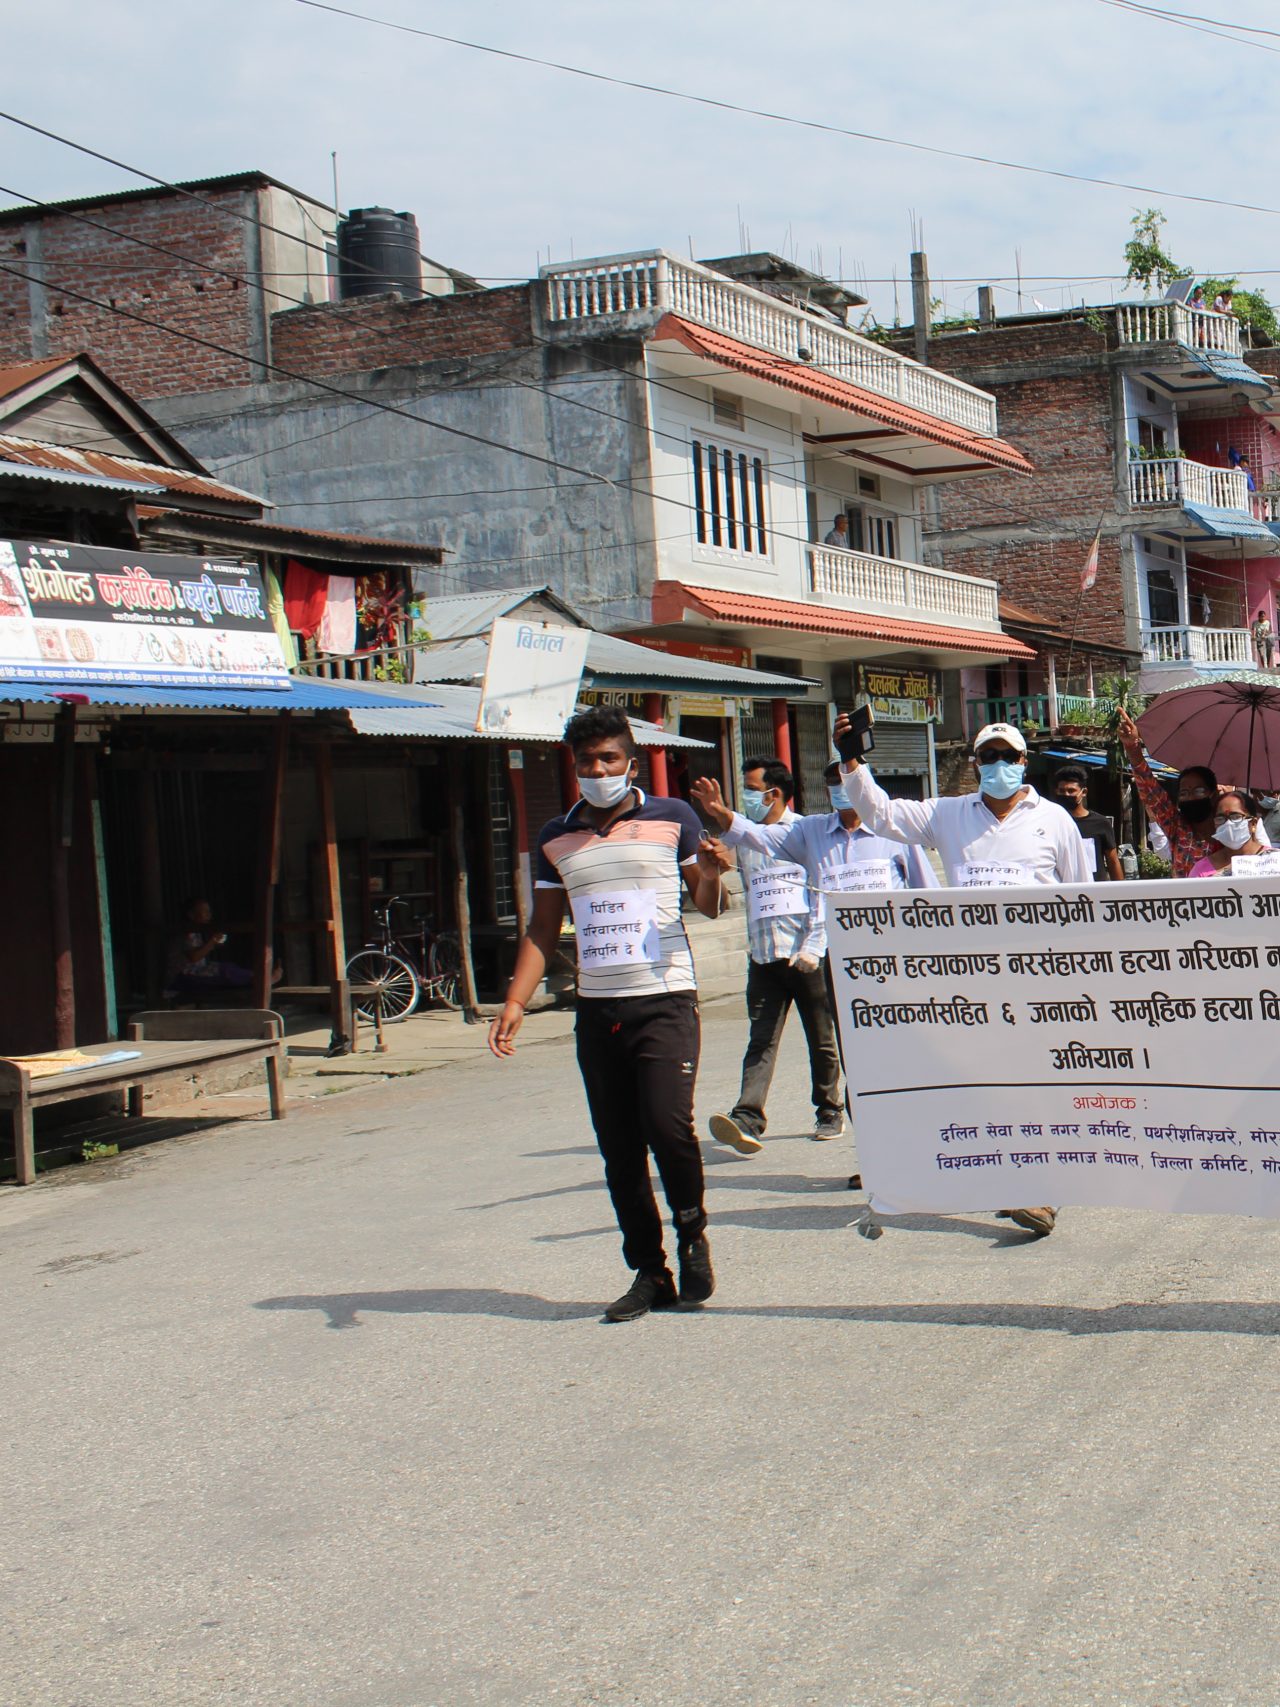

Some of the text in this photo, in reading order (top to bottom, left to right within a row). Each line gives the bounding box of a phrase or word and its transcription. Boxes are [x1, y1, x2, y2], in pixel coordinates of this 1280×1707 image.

[590, 901, 626, 915] पिडित
[835, 900, 895, 935] सम्पूर्ण
[900, 898, 954, 929] दलित
[959, 903, 998, 927] तथा
[1003, 894, 1095, 927] न्यायप्रेमी
[1100, 888, 1243, 928] जनसमूदायको
[903, 953, 1001, 979] हत्याकाण्ड
[1006, 947, 1114, 977] नरसंहारमा
[1119, 949, 1171, 975] हत्या
[1177, 939, 1259, 971] गरिएका
[851, 994, 989, 1029] विश्वकर्मासहित
[1001, 1002, 1016, 1026] ६
[1027, 993, 1098, 1024] जनाको
[1110, 990, 1196, 1028] सामूहिक
[1202, 998, 1253, 1023] हत्या
[1050, 1041, 1134, 1070] अभियान
[1073, 1092, 1137, 1110] आयोजक
[939, 1122, 979, 1143] दलित
[985, 1121, 1014, 1138] सेवा
[1020, 1120, 1044, 1138] संघ
[1050, 1124, 1081, 1139] नगर
[936, 1150, 1003, 1170] विश्वकर्मा
[1009, 1151, 1050, 1169] एकता
[1056, 1151, 1097, 1165] समाज
[1151, 1151, 1193, 1171] जिल्ला
